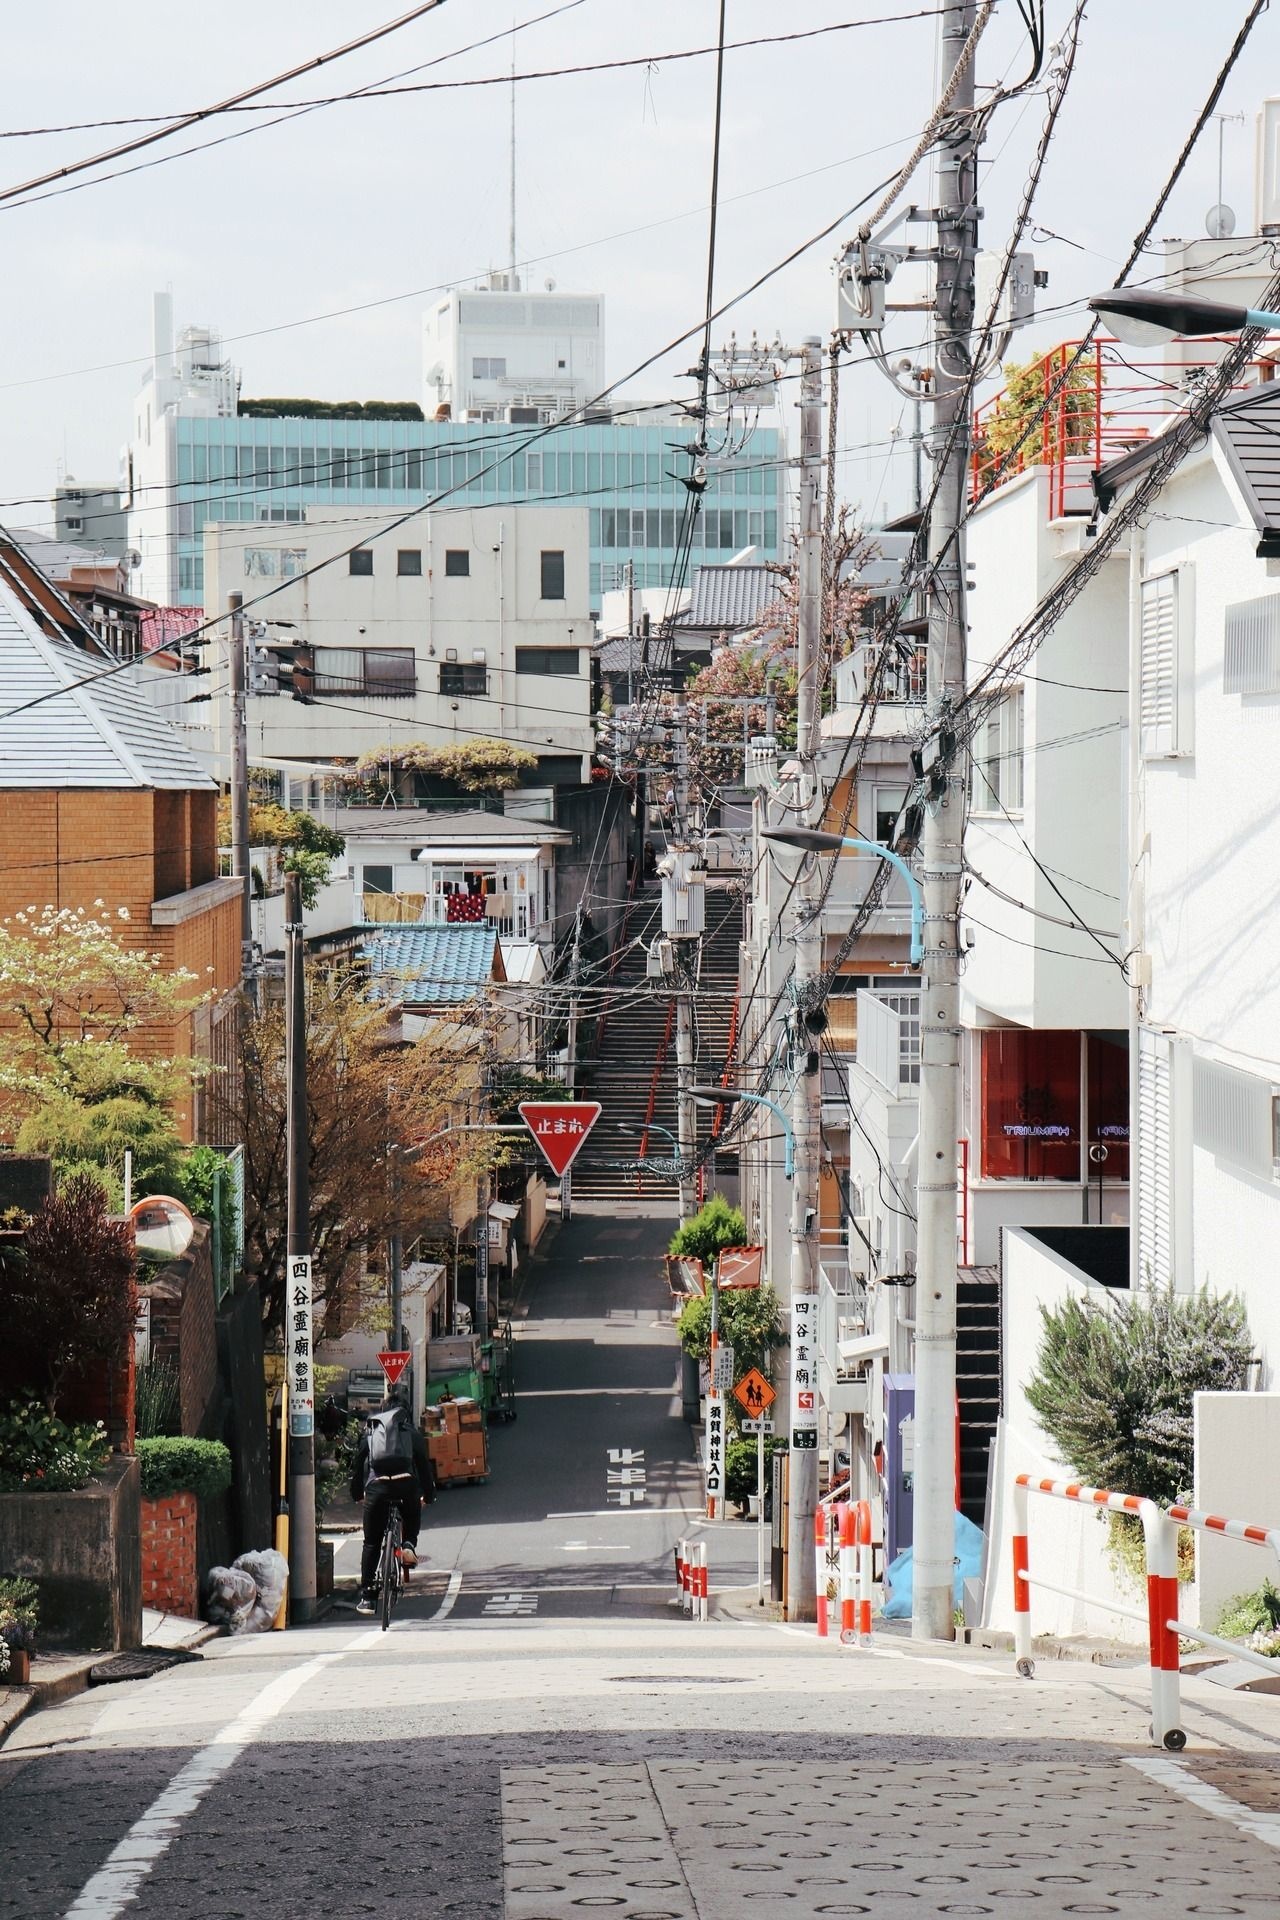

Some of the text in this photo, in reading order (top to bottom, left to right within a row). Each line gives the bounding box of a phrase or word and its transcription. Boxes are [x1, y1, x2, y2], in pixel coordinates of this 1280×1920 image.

[536, 1118, 585, 1135] 止まれ
[1003, 1125, 1070, 1136] TRIUMPH
[292, 1262, 309, 1393] 四谷霊廟参道
[795, 1302, 810, 1387] 四谷霊廟
[384, 1358, 405, 1367] 止まれ
[744, 1422, 772, 1431] 通学路
[707, 1406, 721, 1490] 須賀神社入口
